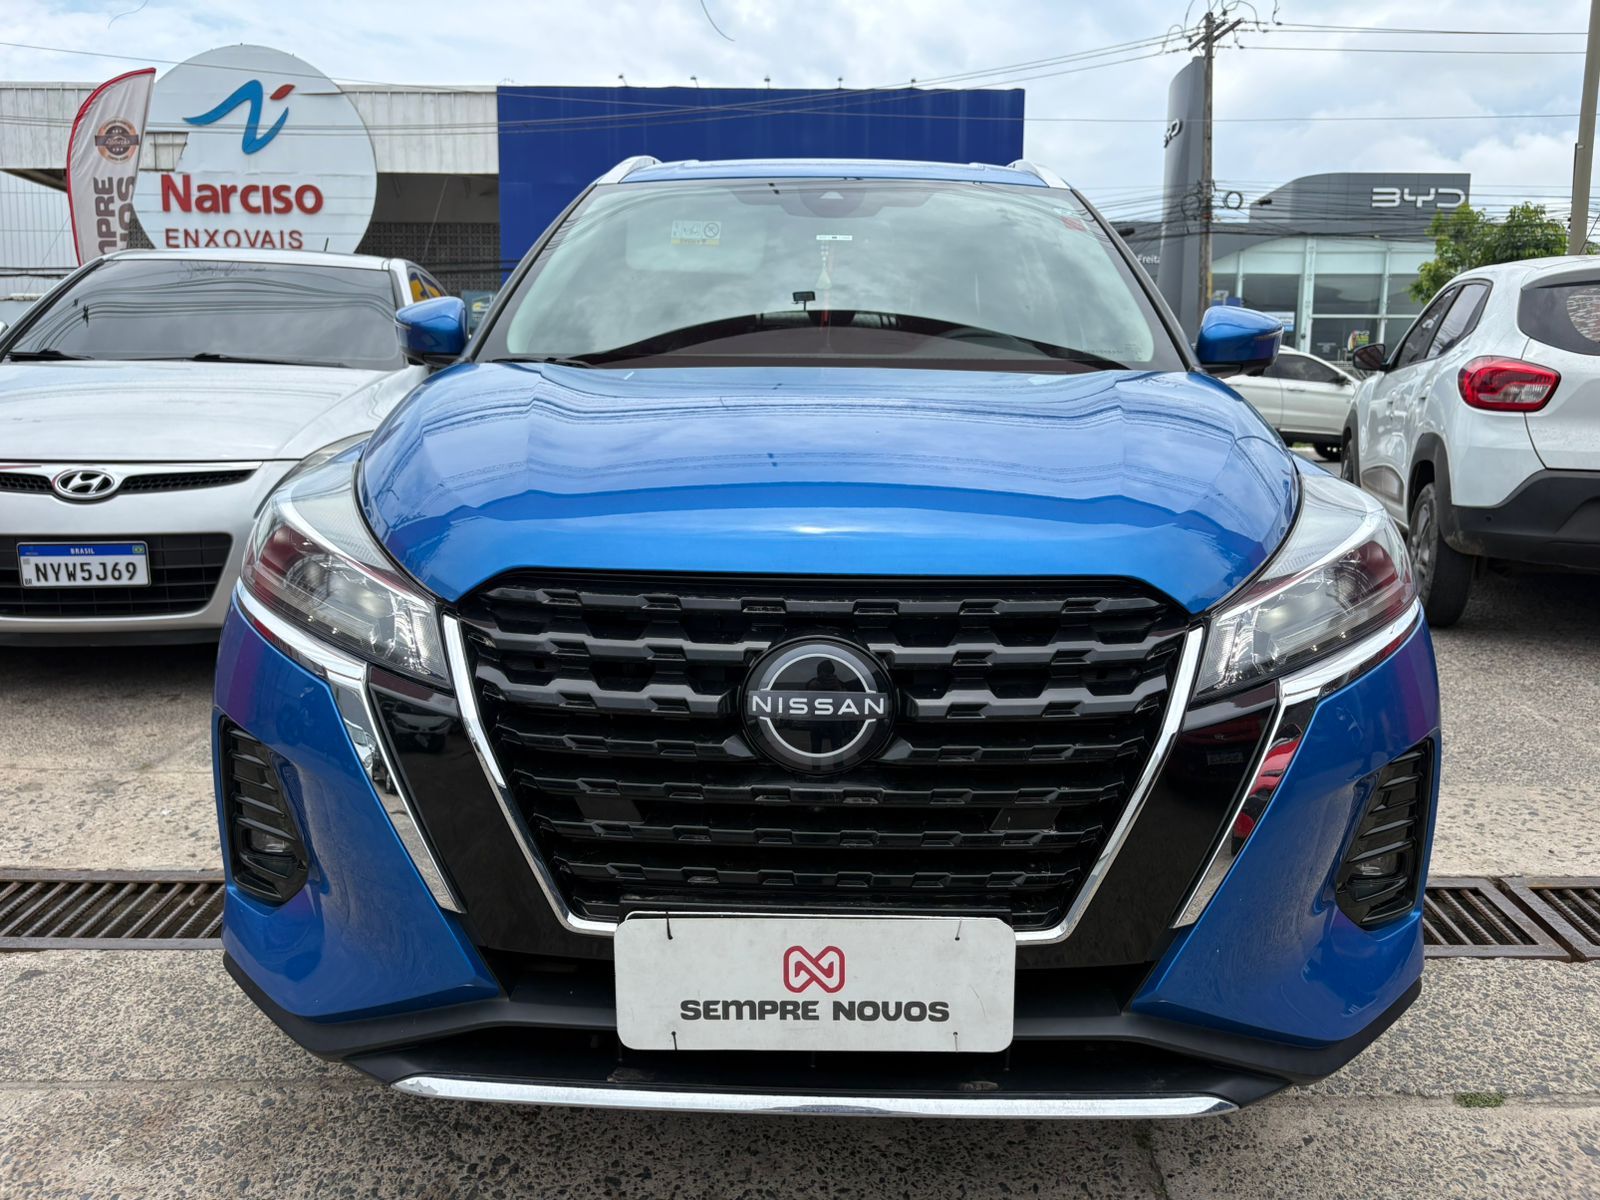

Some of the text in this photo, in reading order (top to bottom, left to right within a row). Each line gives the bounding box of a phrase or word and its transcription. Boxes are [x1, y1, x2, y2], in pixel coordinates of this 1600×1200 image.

[161, 174, 324, 215] Narciso
[1371, 187, 1466, 208] BYD
[165, 228, 304, 249] ENXOVAIS
[70, 547, 95, 555] BRASIL
[34, 561, 138, 583] NYW5J69
[752, 695, 885, 716] NISSAN
[680, 1000, 950, 1022] SEMPRE NOVOS
